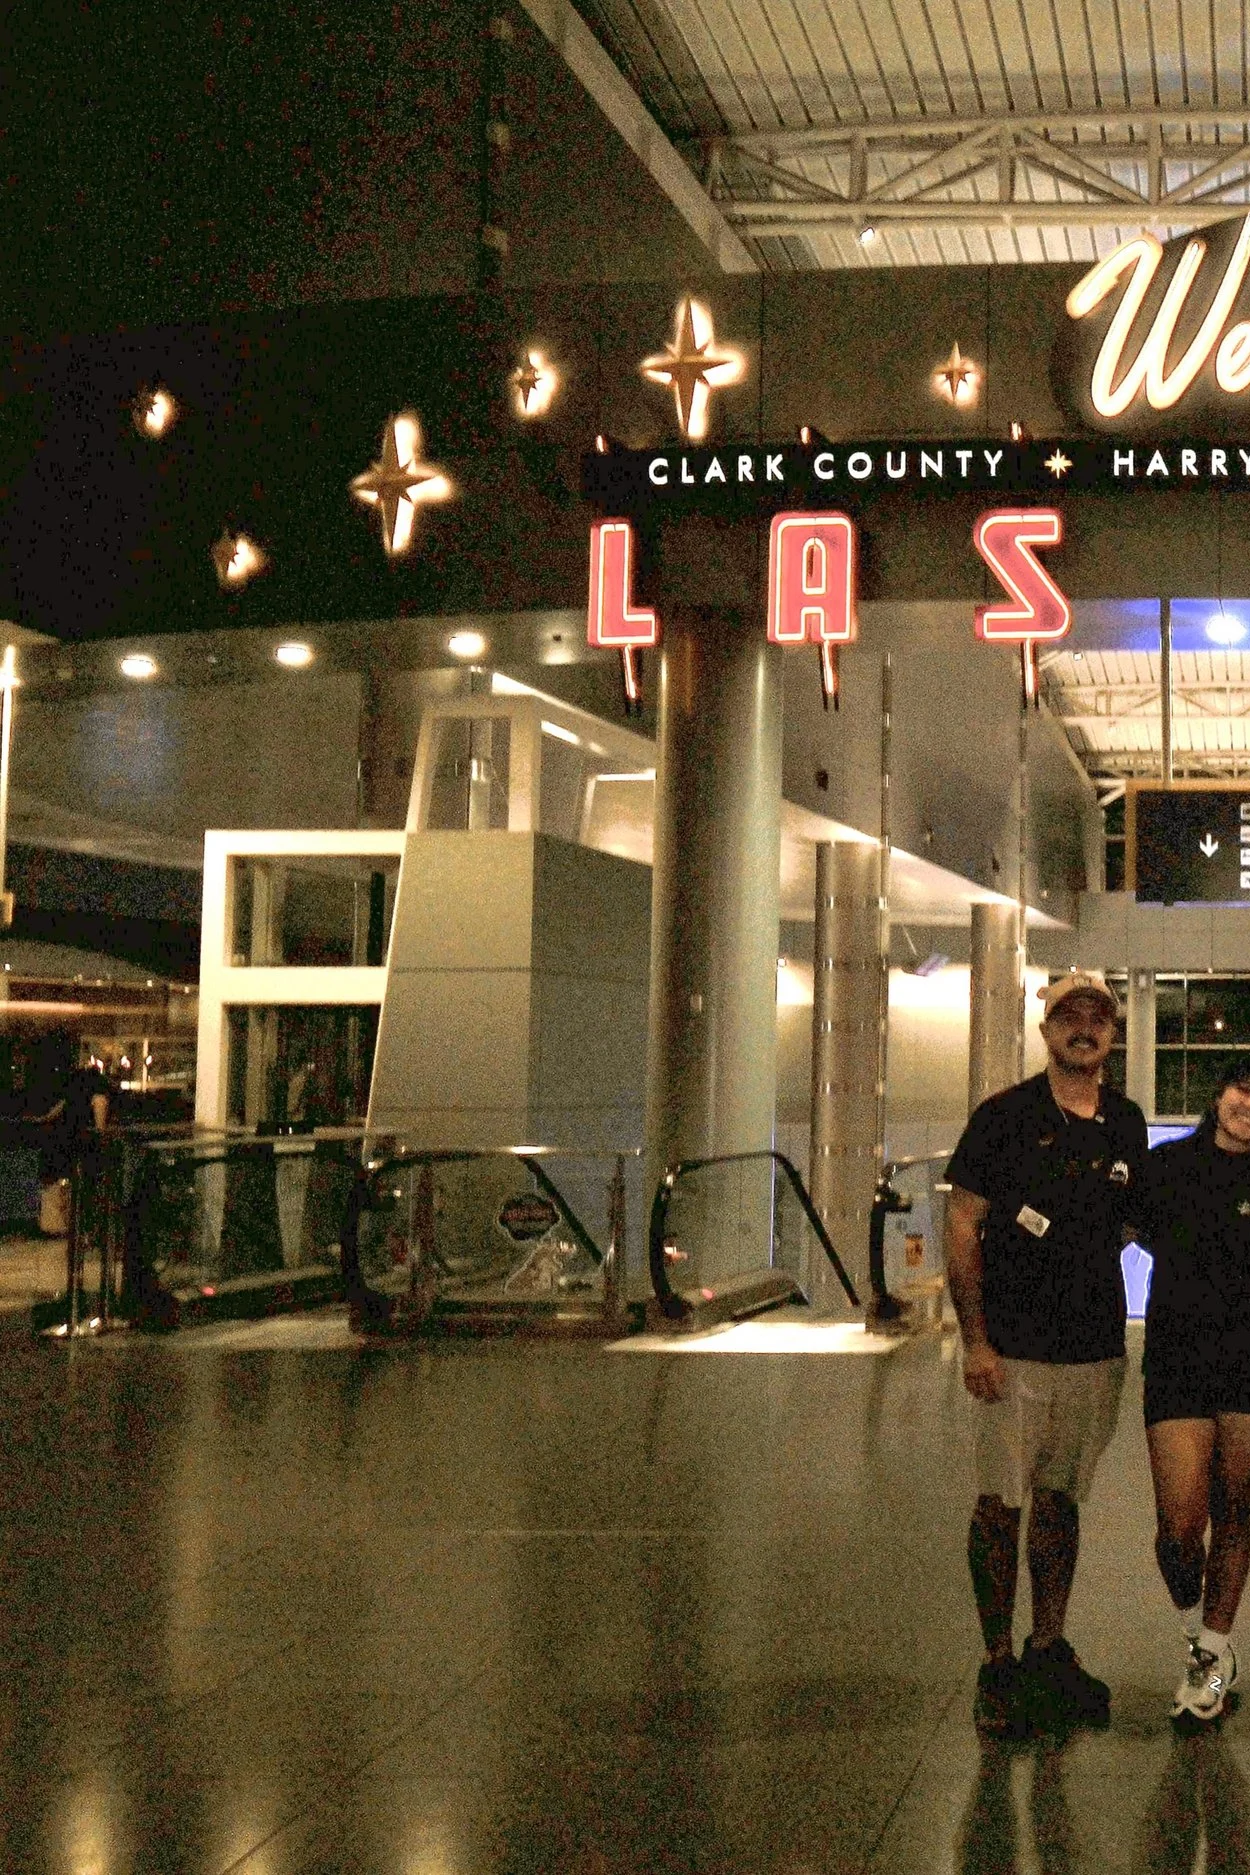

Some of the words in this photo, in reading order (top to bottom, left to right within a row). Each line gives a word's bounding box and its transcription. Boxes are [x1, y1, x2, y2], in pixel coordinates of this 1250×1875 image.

[647, 453, 785, 486] CLARK
[812, 448, 1004, 480] COUNTY
[586, 508, 1073, 646] LAS
